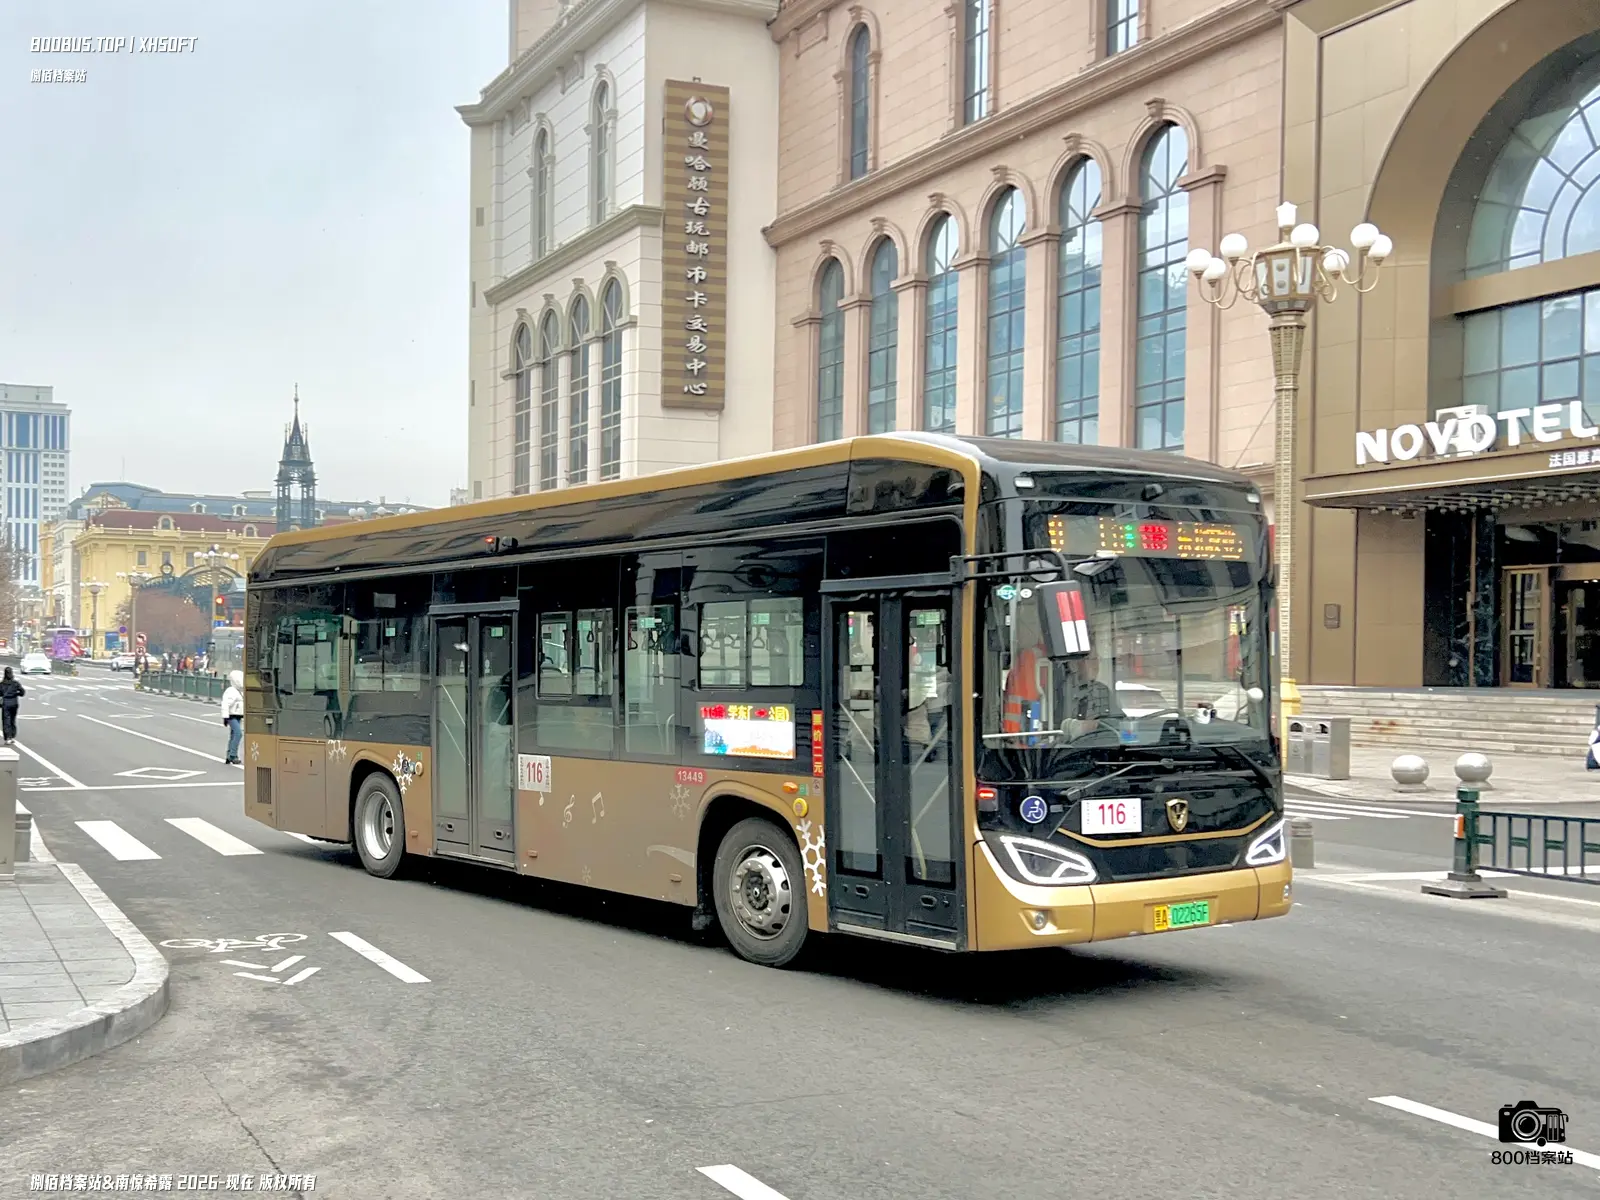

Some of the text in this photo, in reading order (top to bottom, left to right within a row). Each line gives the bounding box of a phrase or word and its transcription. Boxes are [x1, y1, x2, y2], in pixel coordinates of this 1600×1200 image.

[684, 131, 712, 395] 曼哈顿古玩邮币卡交易中心
[1355, 400, 1599, 465] NOVOTEL
[527, 762, 542, 783] 116
[677, 770, 703, 782] 13449
[1098, 803, 1126, 825] 116
